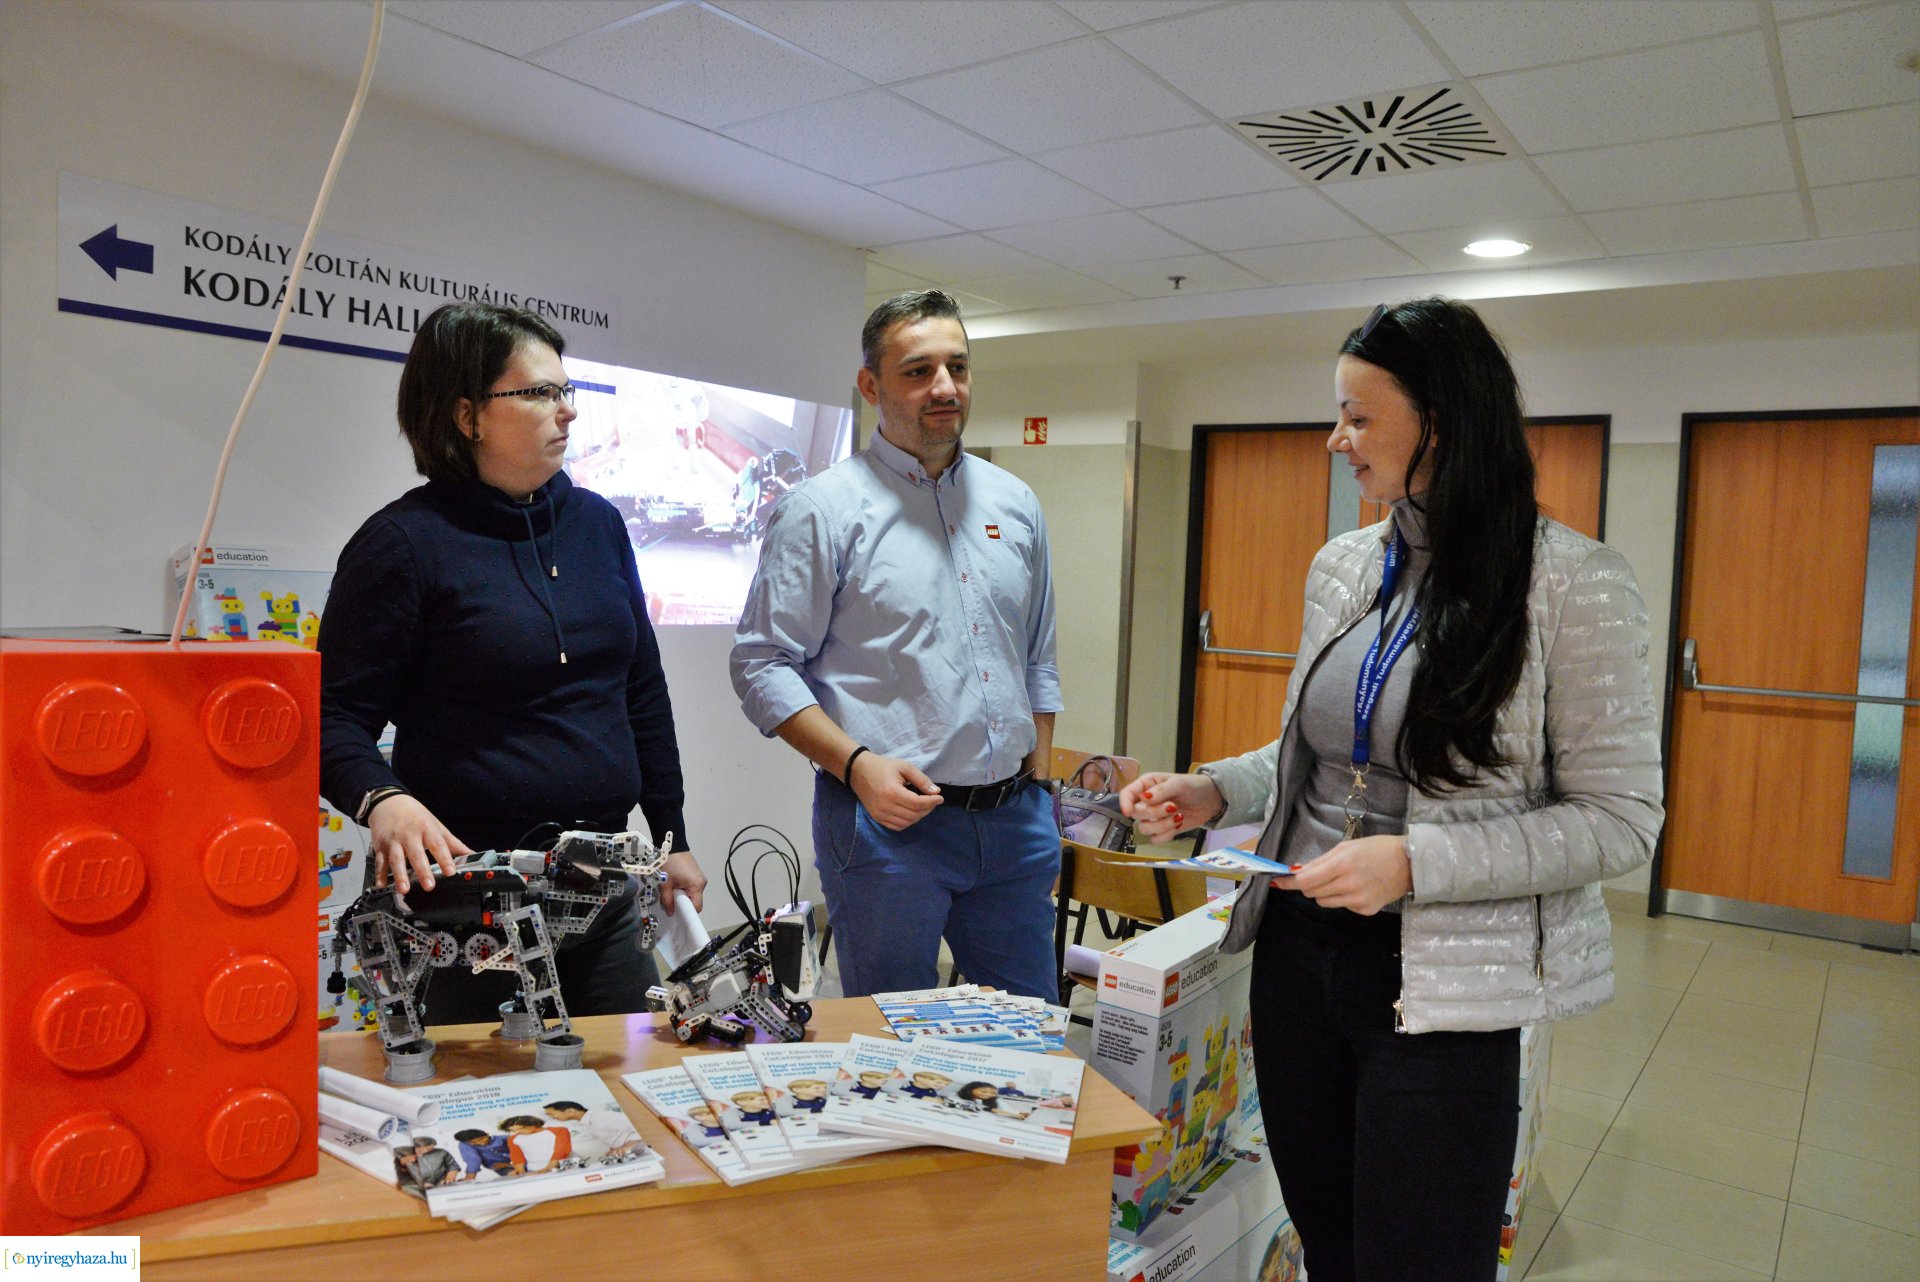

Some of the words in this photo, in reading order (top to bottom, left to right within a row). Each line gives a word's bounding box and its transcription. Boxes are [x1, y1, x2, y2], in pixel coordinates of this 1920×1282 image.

[183, 265, 336, 319] KODÁLY
[184, 225, 292, 265] KODÁLY
[399, 270, 518, 308] KULTURÁLIS
[524, 297, 609, 329] CENTRUM
[216, 551, 269, 562] education
[198, 579, 215, 590] 3-5
[52, 709, 136, 752] LEGO
[217, 705, 293, 745] LEGO
[52, 856, 136, 904] LEGO
[215, 844, 289, 886] LEGO
[1119, 980, 1156, 997] education
[1181, 959, 1218, 990] education
[215, 981, 289, 1026] LEGO
[54, 1002, 137, 1051] LEGO
[1158, 1030, 1173, 1052] 3-5
[217, 1113, 291, 1162] LEGO
[51, 1144, 135, 1199] LEGO
[1149, 1244, 1197, 1282] education
